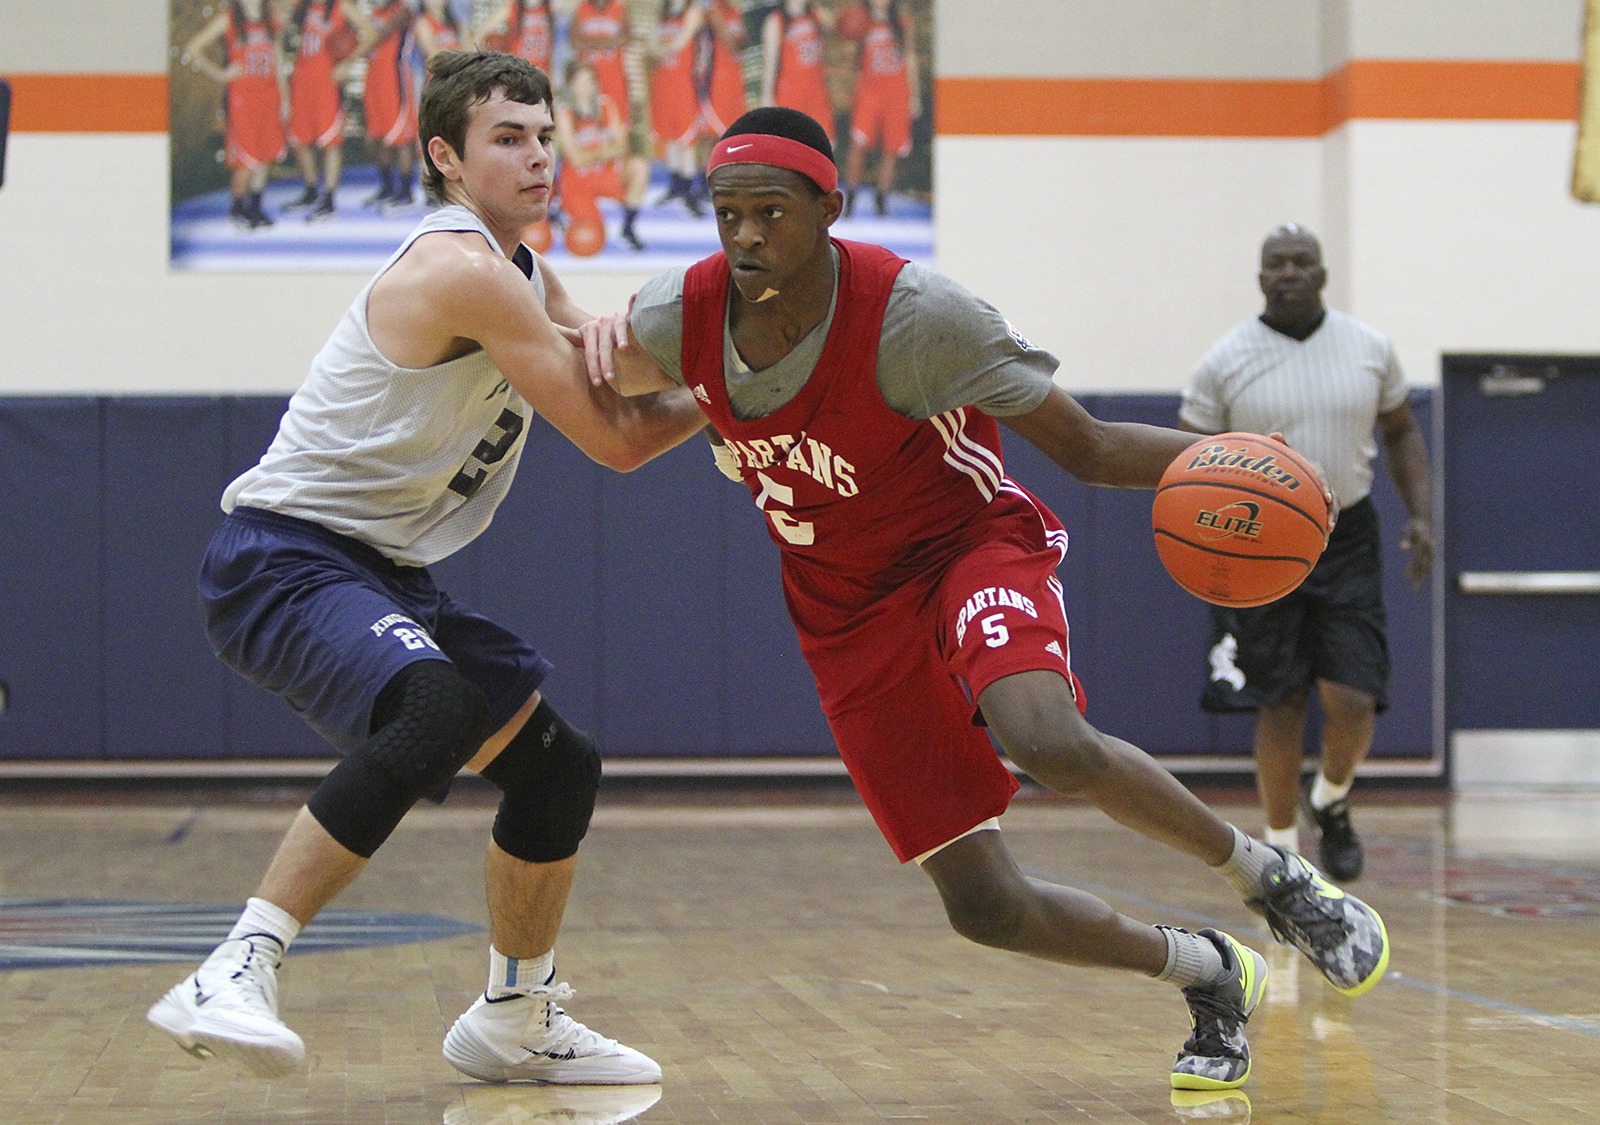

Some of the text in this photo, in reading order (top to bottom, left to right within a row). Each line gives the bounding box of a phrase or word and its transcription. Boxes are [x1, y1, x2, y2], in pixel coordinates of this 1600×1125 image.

[1185, 446, 1301, 491] Baden
[1195, 510, 1264, 538] ELITE
[981, 613, 1010, 648] 5
